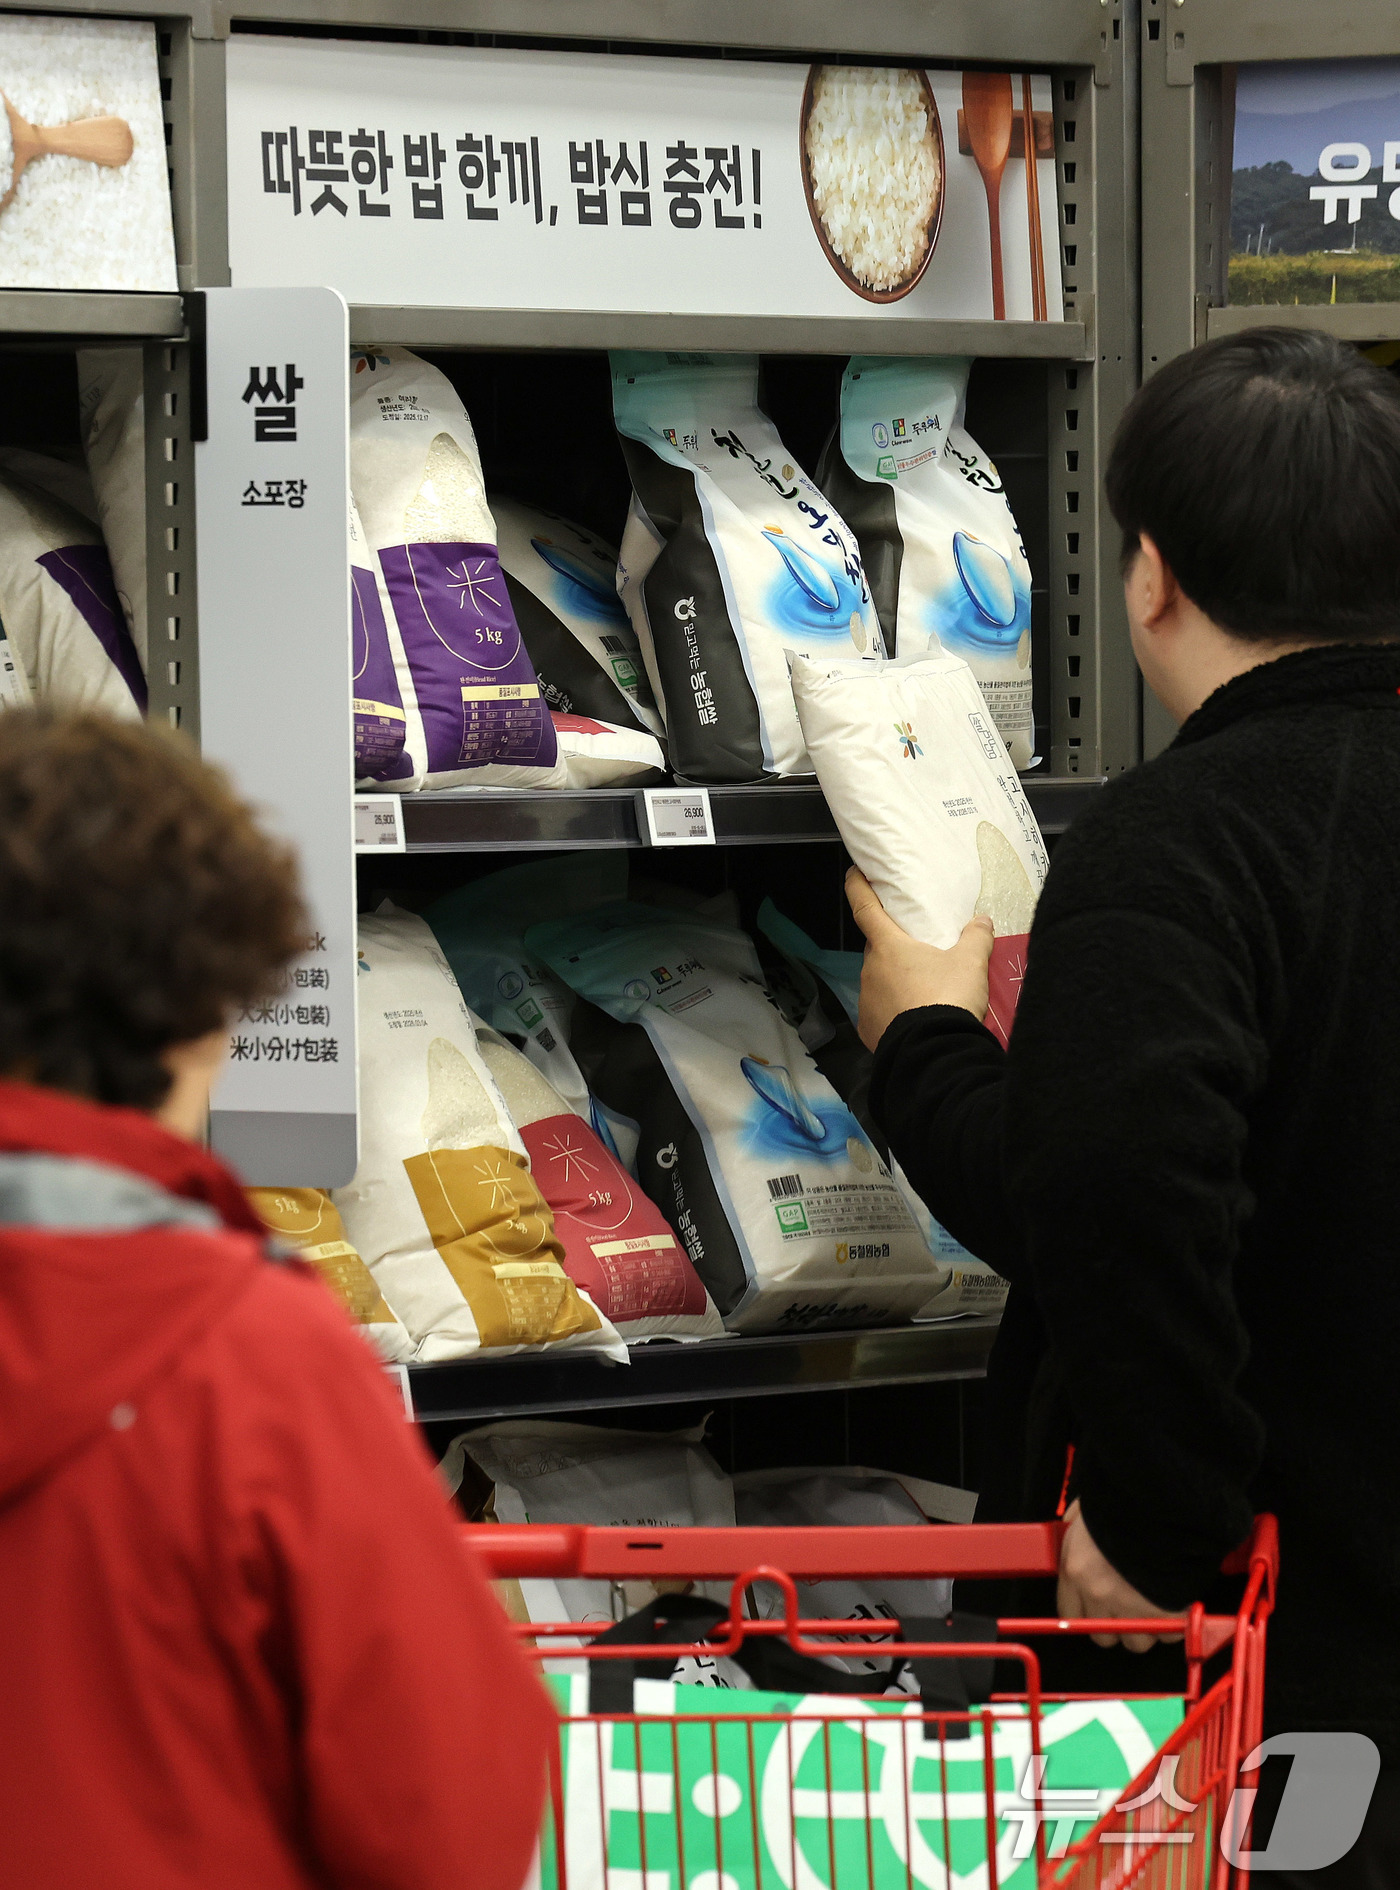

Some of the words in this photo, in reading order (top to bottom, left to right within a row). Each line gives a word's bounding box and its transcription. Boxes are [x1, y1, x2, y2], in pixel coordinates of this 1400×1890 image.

[261, 126, 394, 217] 따뜻한
[402, 132, 447, 220] 밥
[455, 132, 558, 226] 한끼,
[568, 139, 652, 226] 밥심
[662, 140, 763, 229] 충전!
[242, 364, 304, 442] 쌀
[241, 479, 307, 508] 소포장
[474, 628, 484, 645] 5
[485, 626, 504, 645] kg
[684, 622, 701, 670] 믿고먹는
[690, 670, 719, 726] 농협쌀
[683, 807, 706, 819] 26,900
[230, 1035, 339, 1063] 米小分け包装
[282, 1197, 300, 1215] kg
[588, 1193, 597, 1208] 5
[595, 1190, 613, 1206] kg
[782, 1209, 799, 1218] GAP
[678, 1208, 705, 1263] 농협쌀
[849, 1241, 890, 1260] 동철원농협
